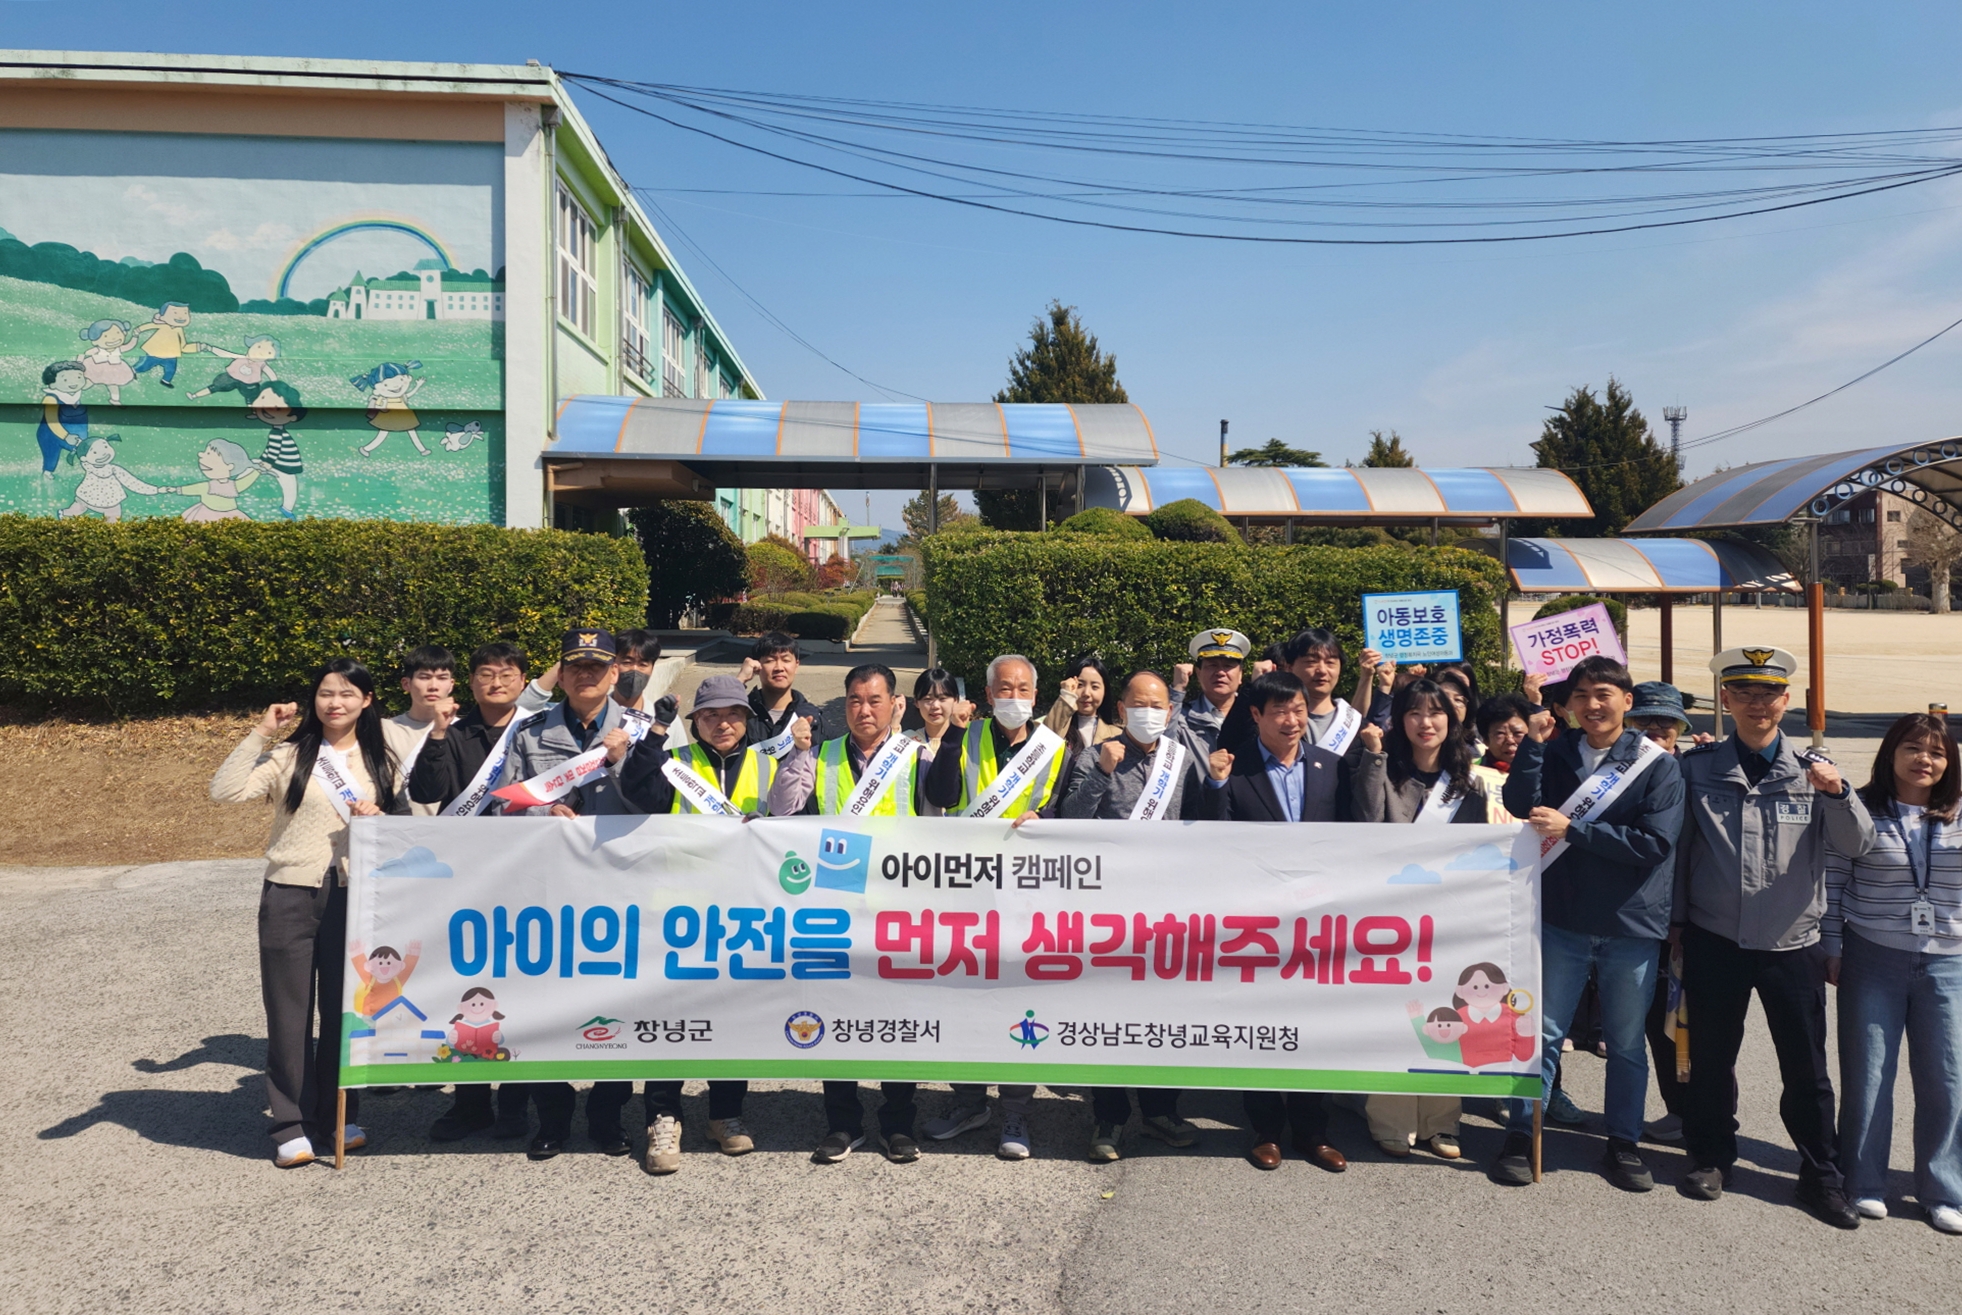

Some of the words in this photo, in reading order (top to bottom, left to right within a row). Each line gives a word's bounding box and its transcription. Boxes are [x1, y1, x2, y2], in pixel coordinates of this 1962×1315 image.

[1377, 605, 1447, 626] 아동보호
[1378, 627, 1448, 648] 생명존중
[1528, 617, 1599, 648] 가정폭력
[1541, 637, 1600, 665] STOP!
[875, 752, 898, 779] 개학기
[1017, 743, 1047, 775] 초등학교
[671, 767, 707, 798] 초등학교
[998, 771, 1021, 798] 개학기
[1152, 770, 1170, 799] 개학기
[1591, 772, 1620, 800] 개학기
[970, 794, 1000, 817] 위해요
[881, 852, 1003, 889] 아이먼저
[1011, 854, 1102, 890] 캠페인
[448, 904, 640, 979] 아이의
[662, 904, 853, 980] 안전을
[875, 908, 1001, 981] 먼저
[1021, 910, 1435, 985] 생각해주세요!
[633, 1019, 713, 1043] 창녕군
[831, 1018, 941, 1043] 창녕경찰서
[1056, 1020, 1300, 1052] 경상남도창녕교육지원청
